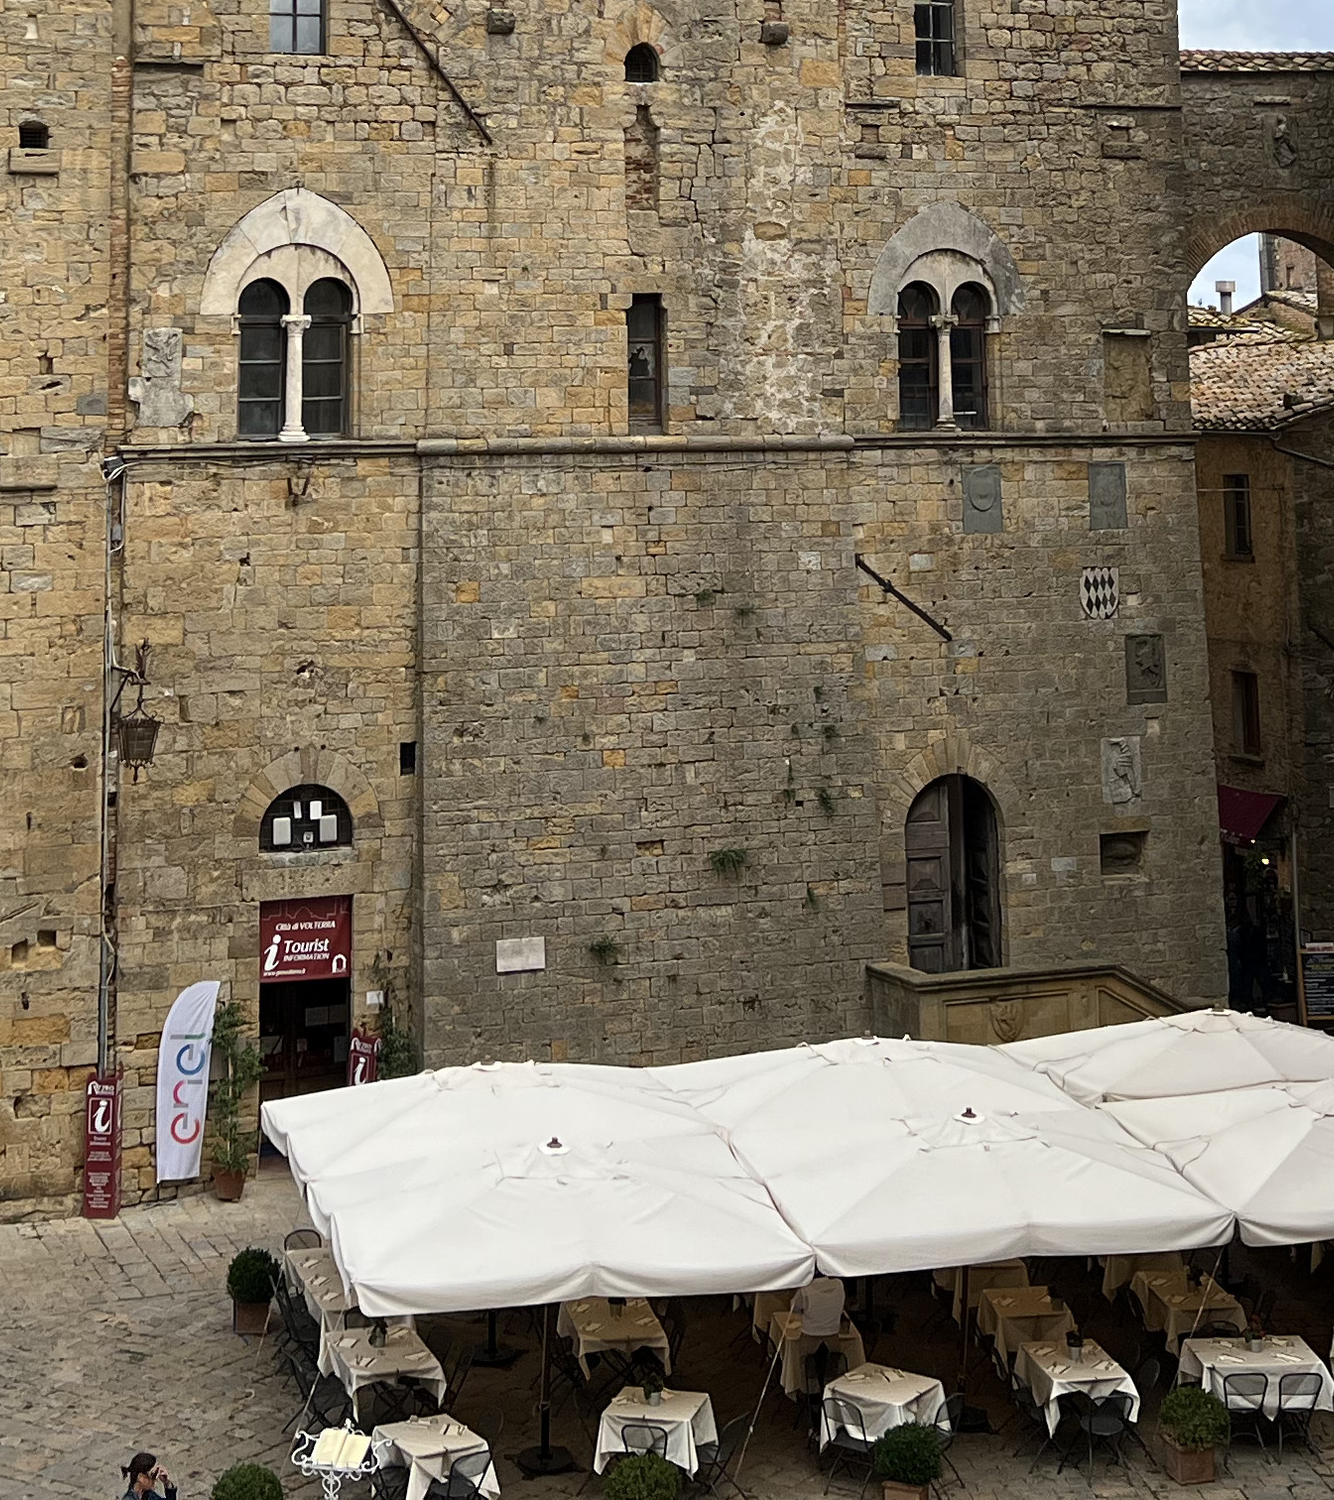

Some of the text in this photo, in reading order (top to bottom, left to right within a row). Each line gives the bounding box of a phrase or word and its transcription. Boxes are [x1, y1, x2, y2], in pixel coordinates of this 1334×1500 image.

[300, 920, 336, 930] VOLTERRA
[283, 938, 329, 954] Tourist
[283, 954, 330, 962] INFORMATION
[170, 1032, 206, 1144] enel
